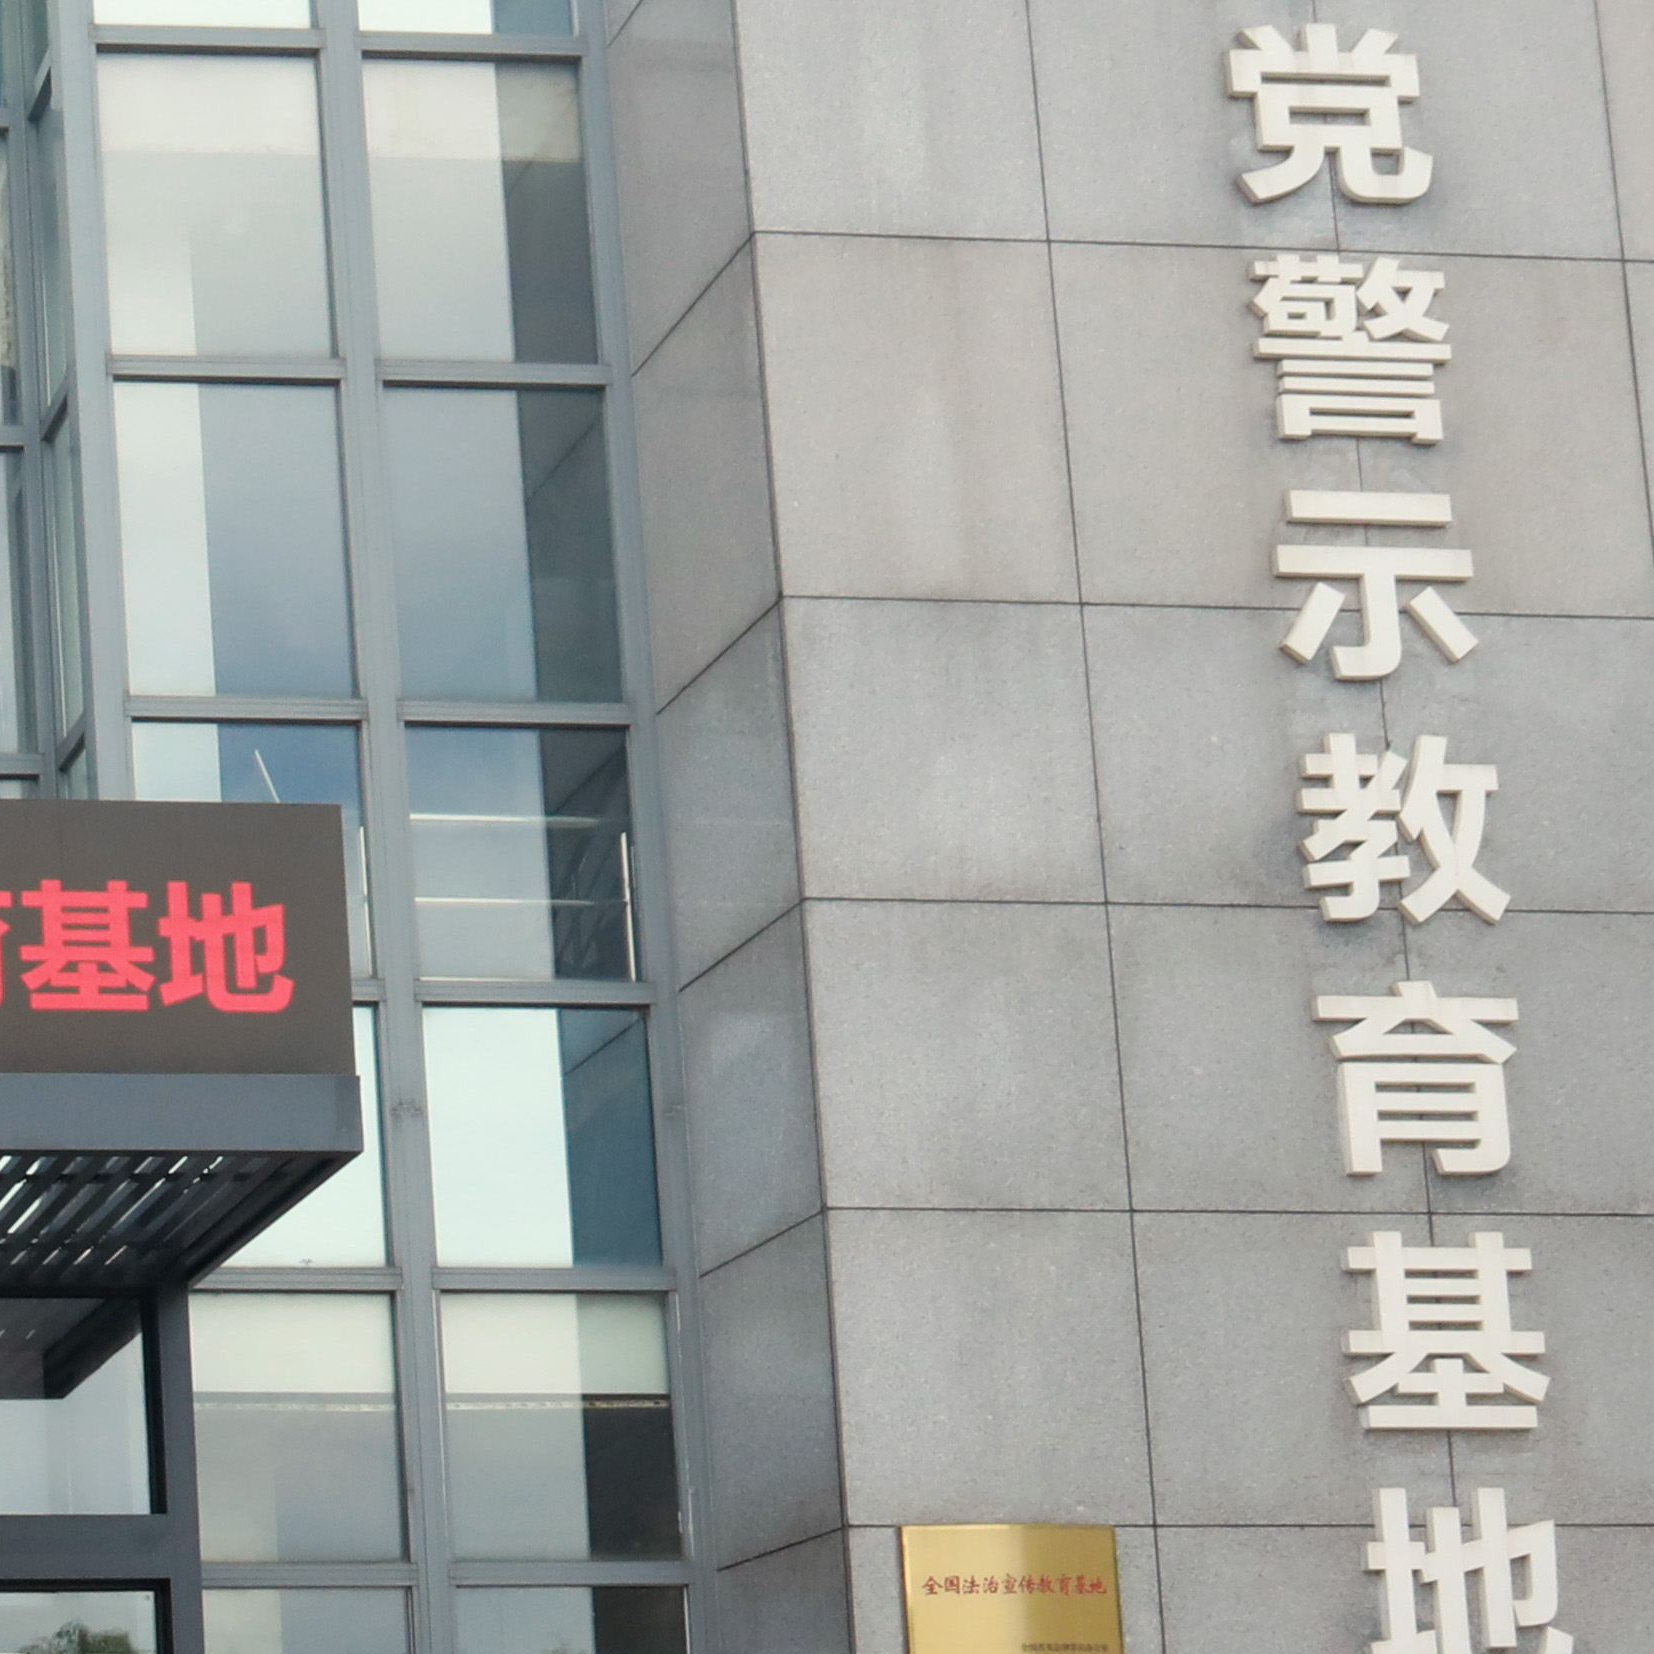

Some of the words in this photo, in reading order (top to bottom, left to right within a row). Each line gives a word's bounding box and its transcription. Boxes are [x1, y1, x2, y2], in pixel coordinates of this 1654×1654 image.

[922, 1574, 1108, 1596] 全国法治宣传教育基地
